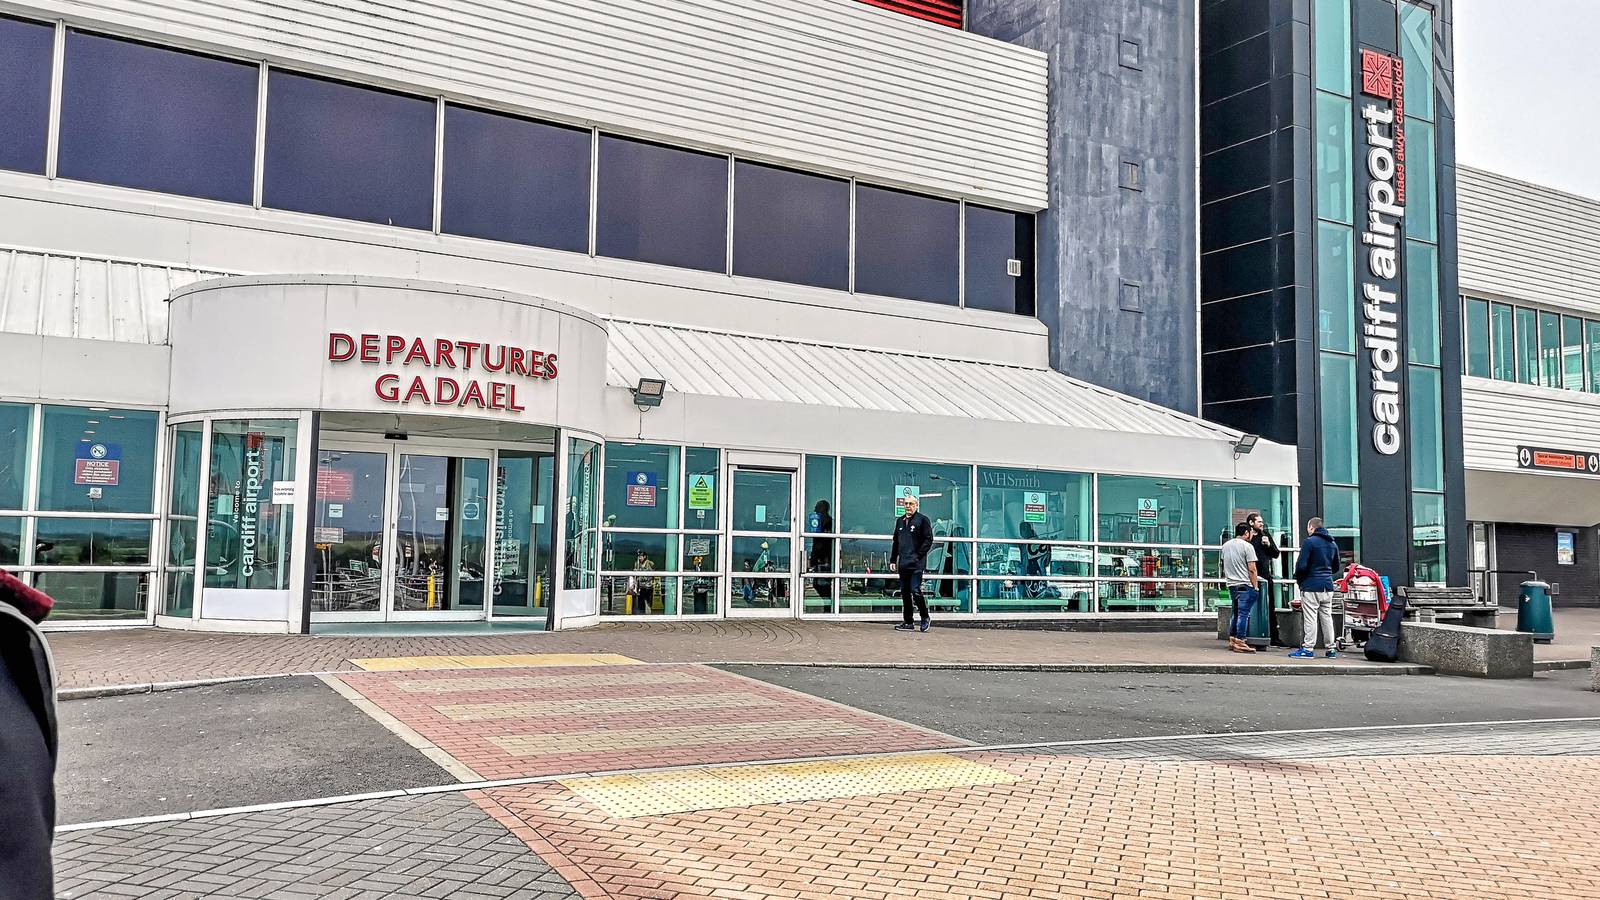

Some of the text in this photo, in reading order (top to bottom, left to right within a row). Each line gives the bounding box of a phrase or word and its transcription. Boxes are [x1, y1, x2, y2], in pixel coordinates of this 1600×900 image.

[1393, 58, 1406, 203] maes awyr caerdydd
[1362, 103, 1404, 455] cardiff airport
[328, 332, 558, 380] DEPARTURES
[374, 373, 526, 412] GADAEL
[243, 450, 262, 514] airport
[983, 471, 1041, 488] WHSmith
[241, 515, 256, 578] cardiff
